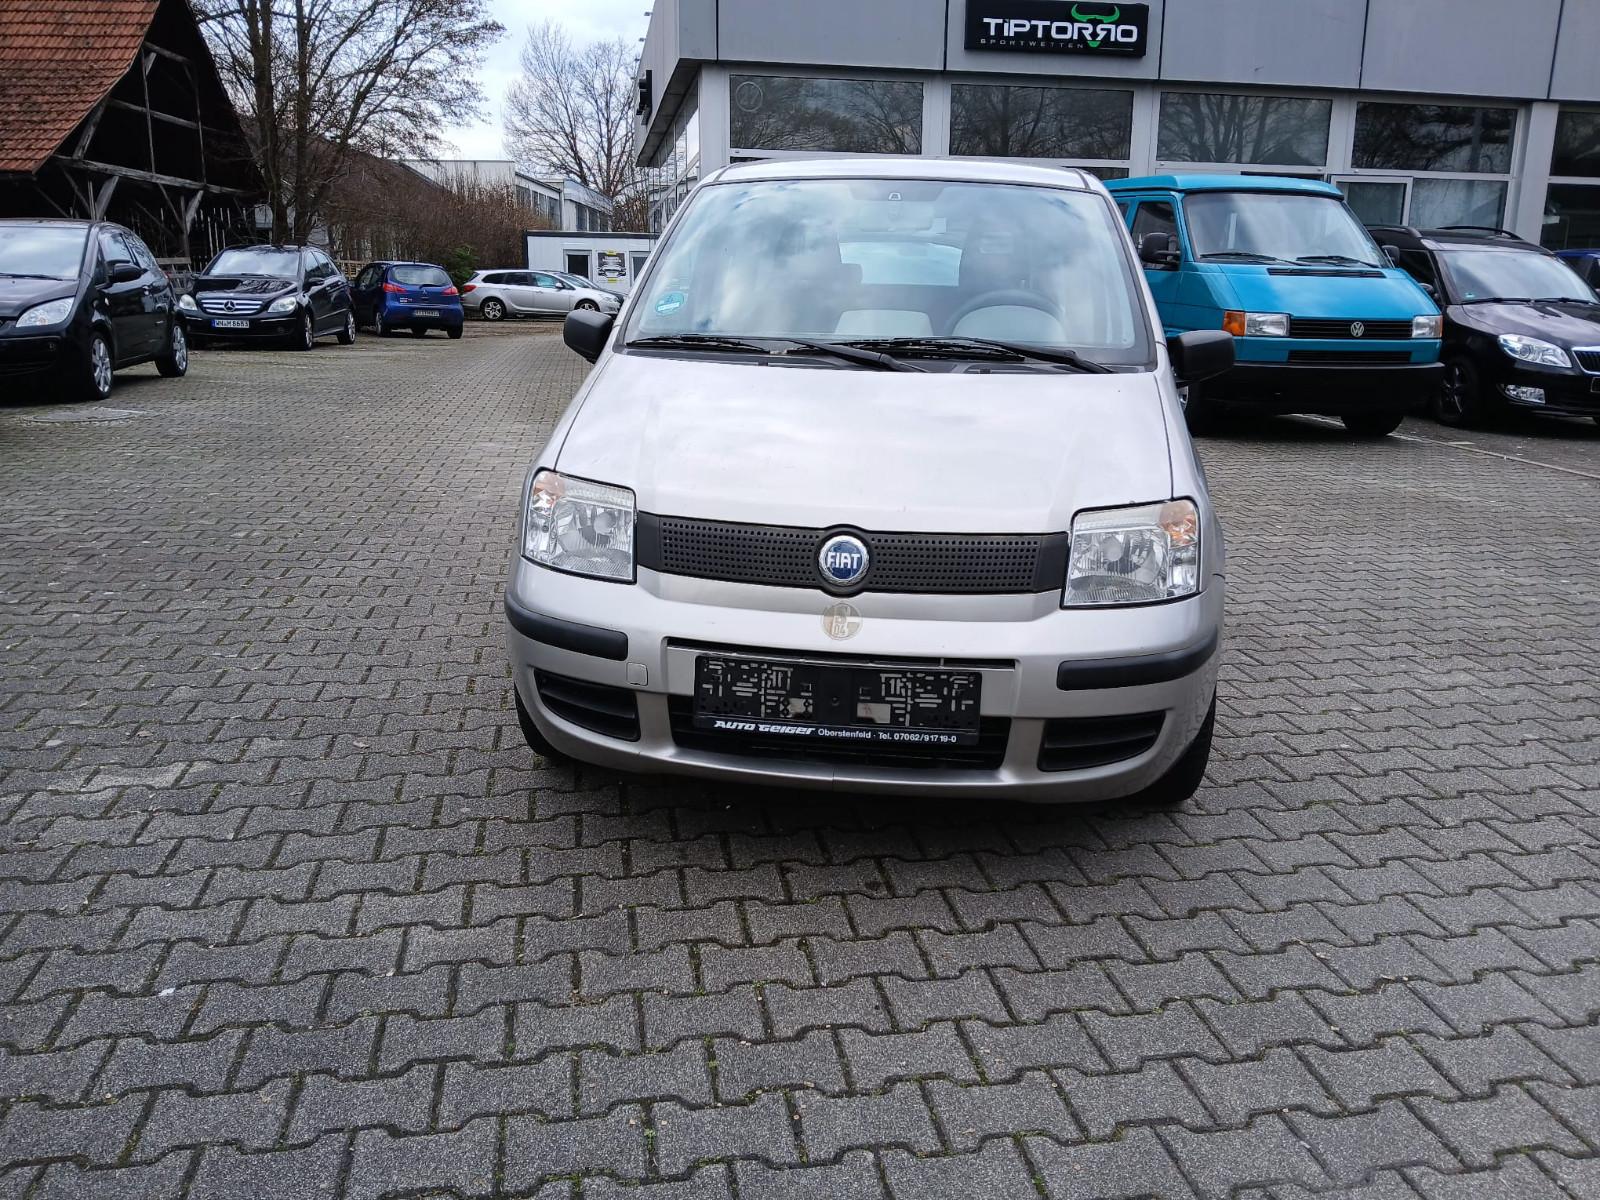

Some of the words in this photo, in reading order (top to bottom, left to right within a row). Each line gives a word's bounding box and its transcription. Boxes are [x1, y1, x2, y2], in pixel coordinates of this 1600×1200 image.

[980, 38, 1084, 49] SPORTWETTEN
[827, 551, 860, 569] FIAT
[714, 720, 756, 731] AUTO
[818, 728, 871, 739] Oberstenfeld
[879, 731, 892, 740] Tel.
